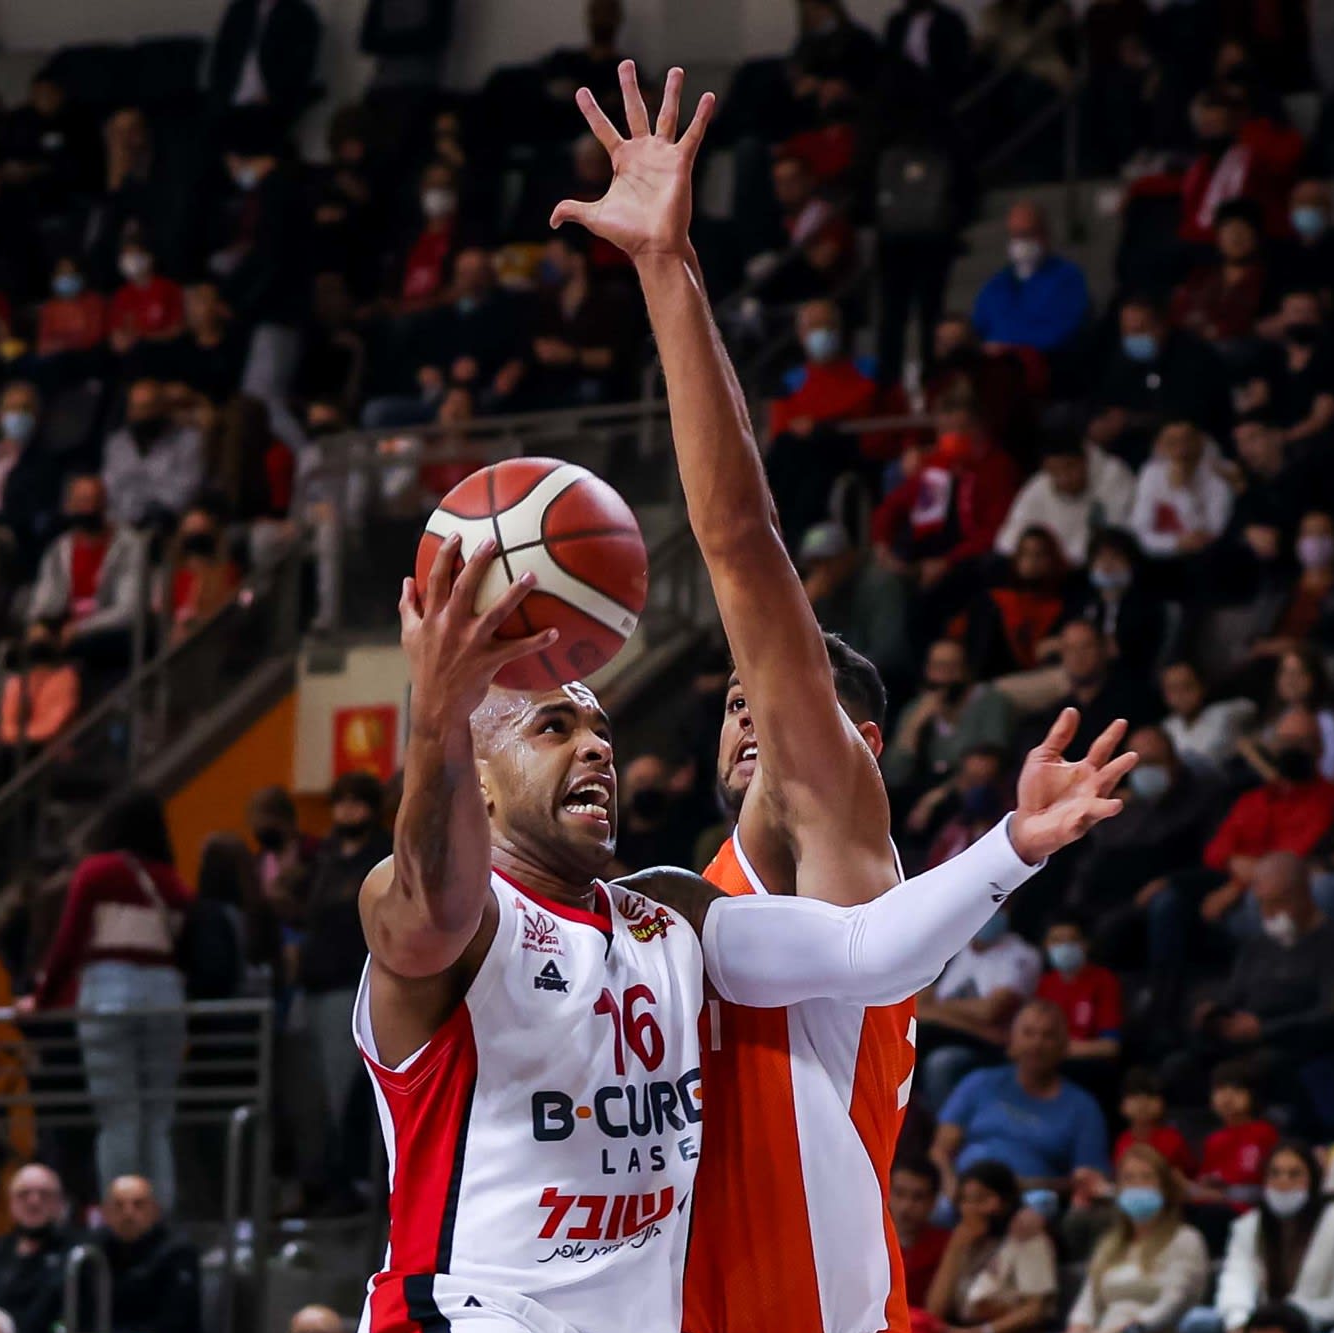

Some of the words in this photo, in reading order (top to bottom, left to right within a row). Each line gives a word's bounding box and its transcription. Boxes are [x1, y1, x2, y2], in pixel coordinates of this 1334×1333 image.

[593, 984, 665, 1075] 16
[602, 1136, 699, 1175] LASE
[537, 1186, 674, 1240] שובל
